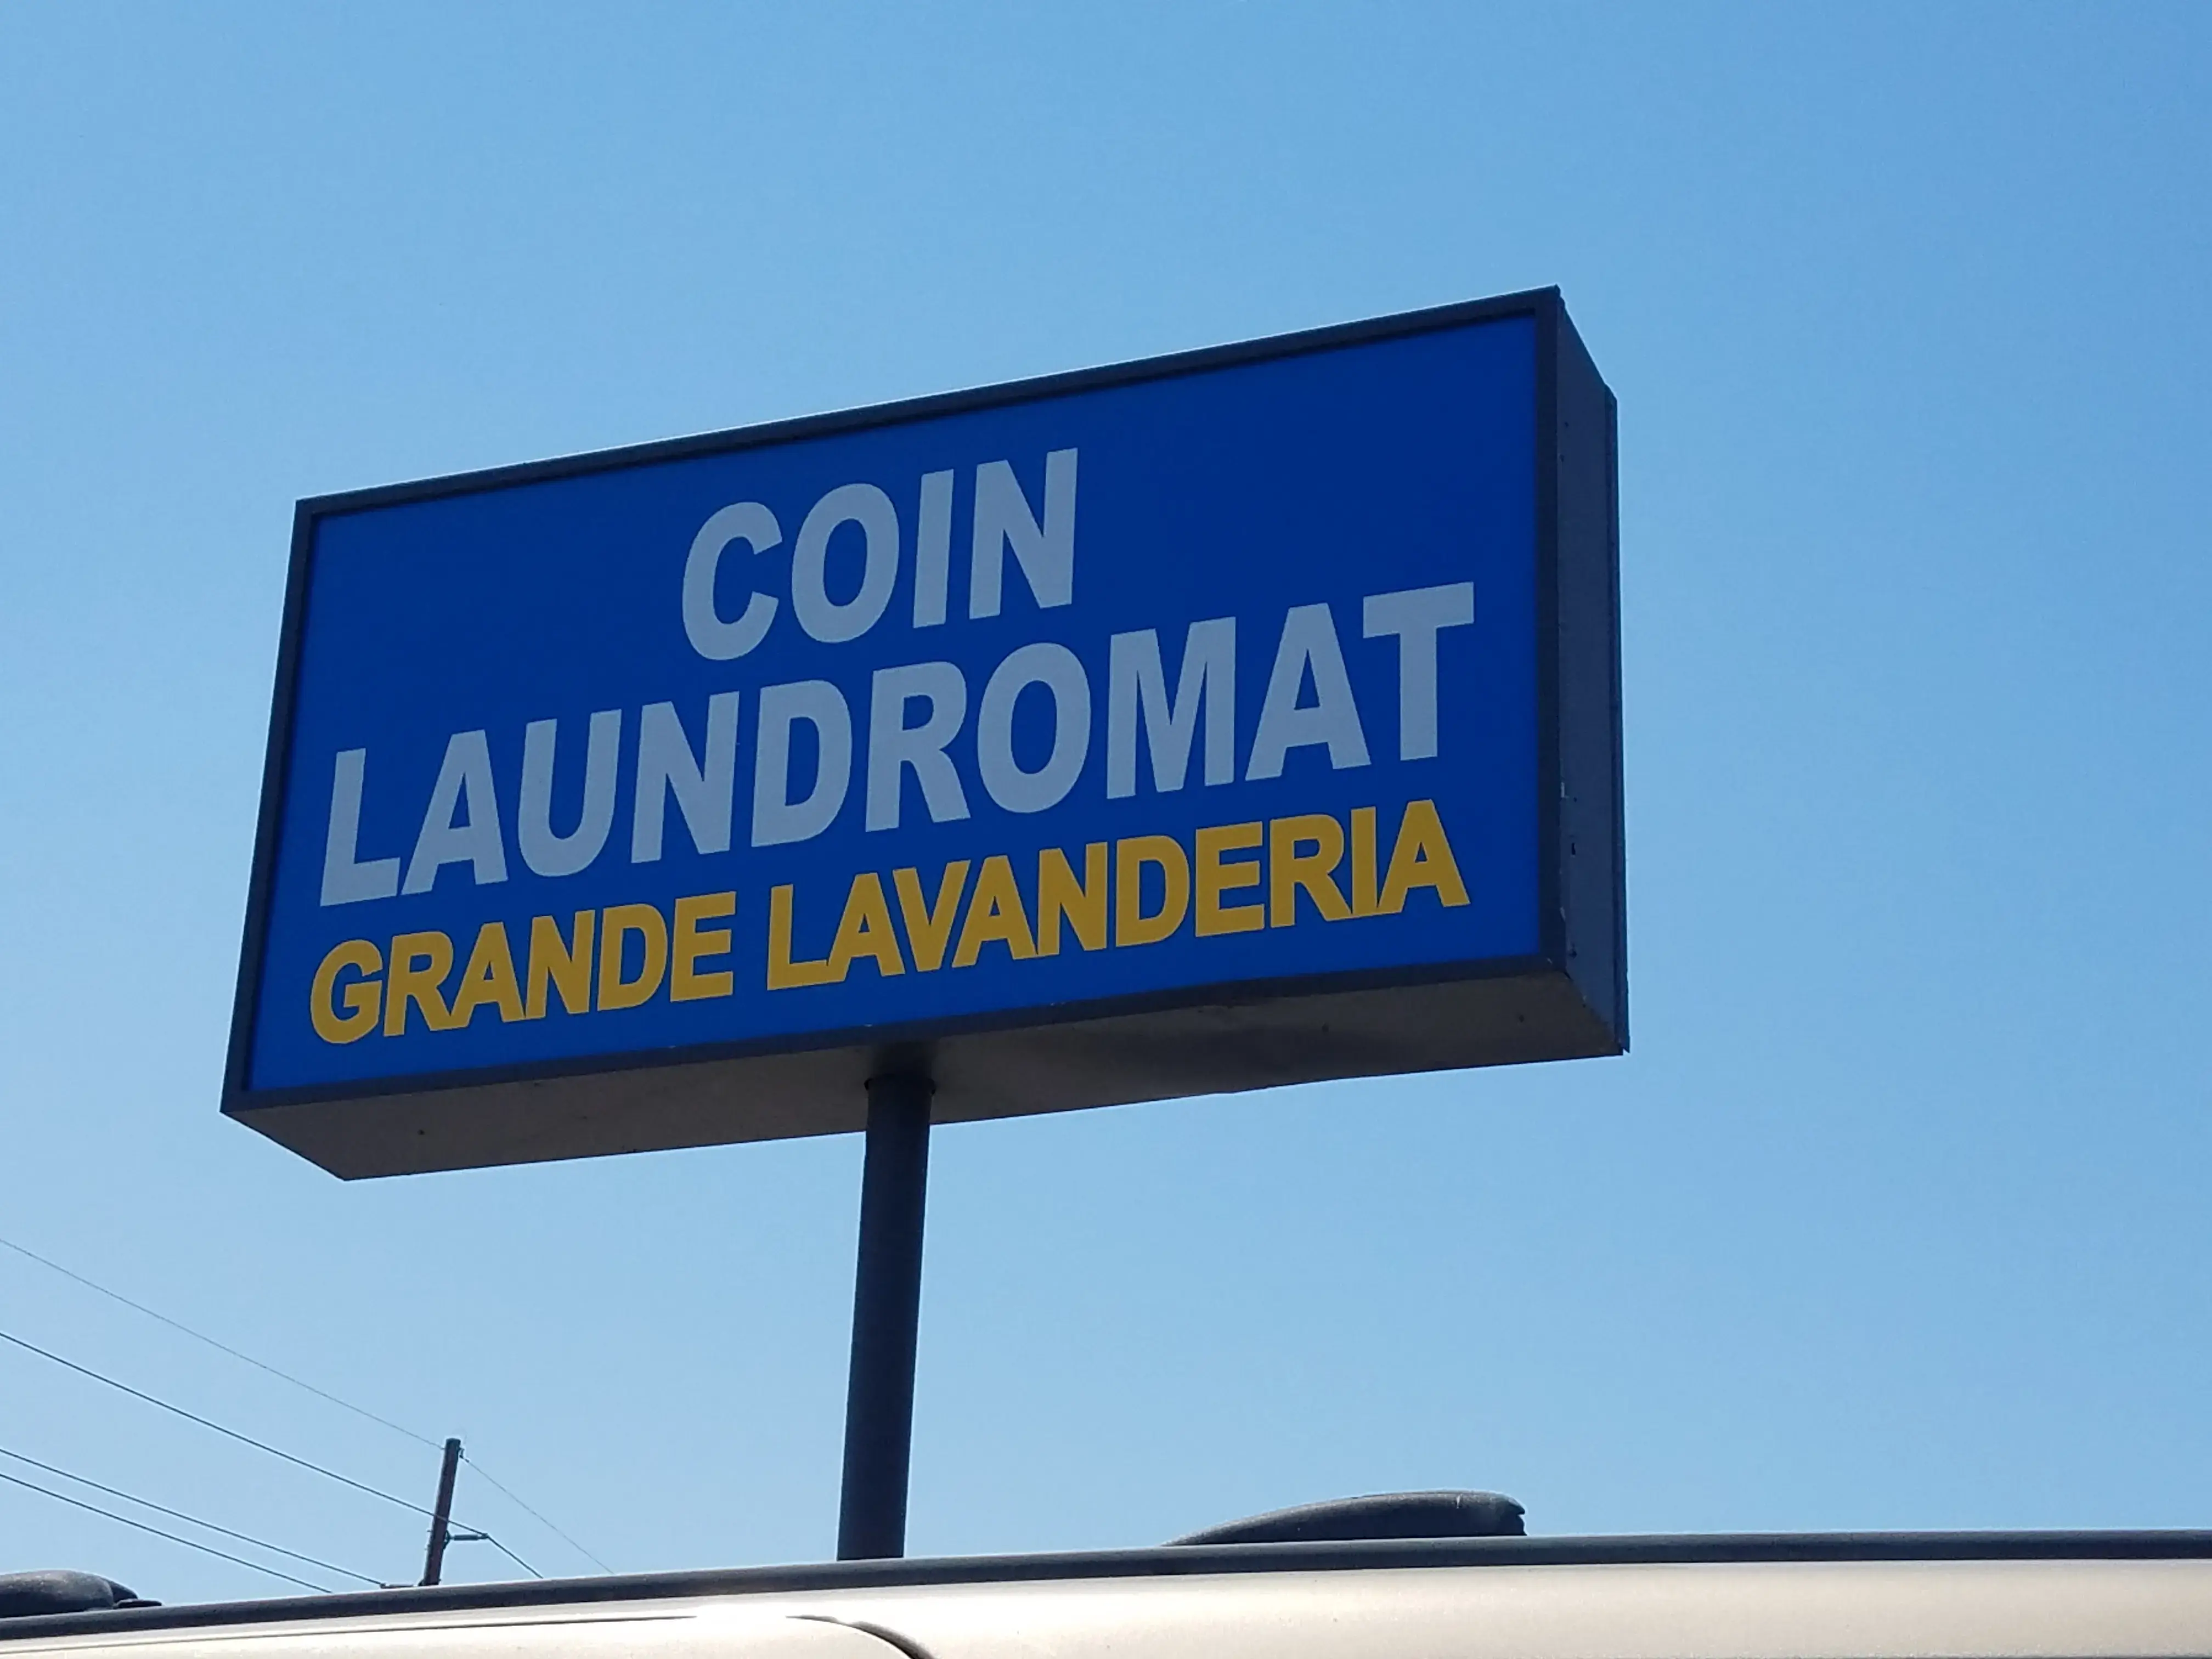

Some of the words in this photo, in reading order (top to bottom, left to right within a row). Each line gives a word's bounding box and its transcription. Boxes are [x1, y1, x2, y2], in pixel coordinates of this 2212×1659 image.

[682, 448, 1077, 660] COIN
[320, 583, 1474, 906] LAUNDROMAT
[310, 891, 736, 1044] GRANDE
[766, 799, 1470, 991] LAVANDERIA
